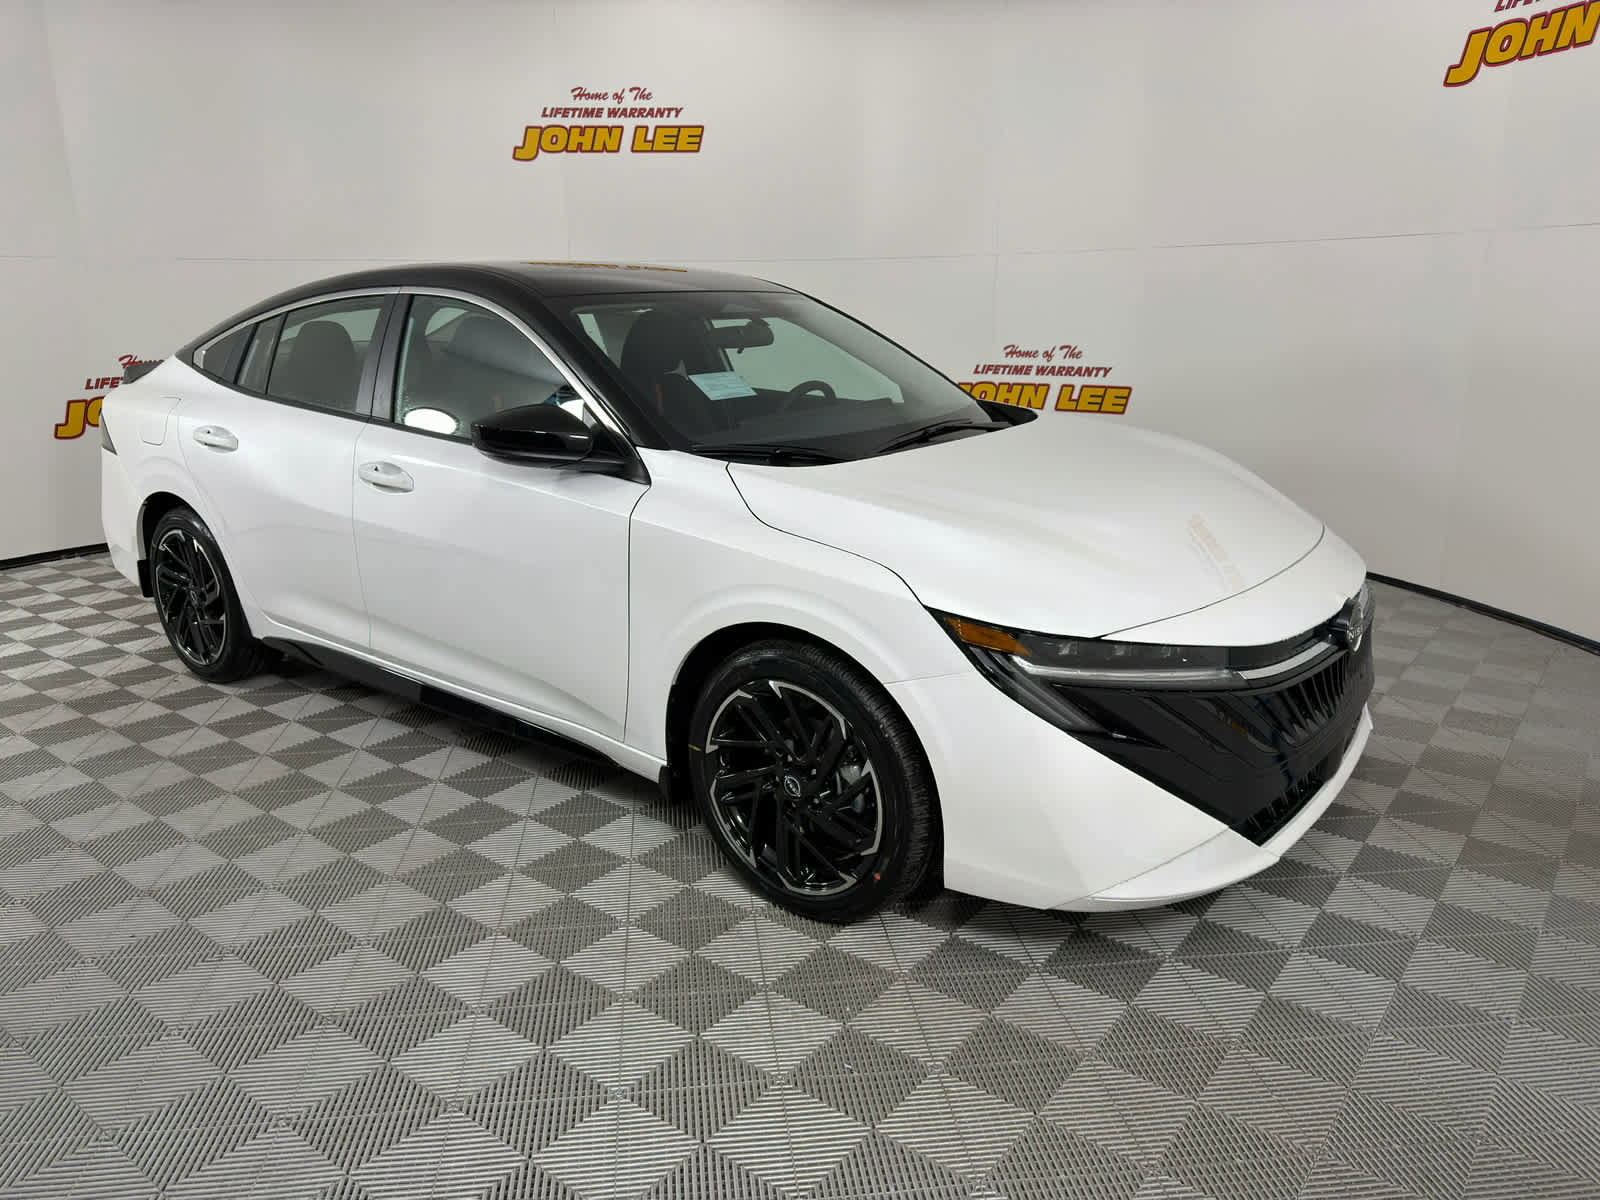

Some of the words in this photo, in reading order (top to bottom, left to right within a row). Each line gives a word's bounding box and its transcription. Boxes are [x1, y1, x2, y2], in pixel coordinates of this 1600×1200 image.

[1443, 0, 1600, 87] JOHN
[571, 86, 609, 101] Home
[612, 88, 625, 104] of
[629, 87, 652, 101] The
[541, 107, 604, 118] LIFETIME
[607, 107, 683, 118] WARRANTY
[512, 125, 624, 161] JOHN
[631, 125, 704, 152] LEE
[1003, 344, 1039, 359] Home
[1042, 346, 1056, 362] of
[1059, 345, 1082, 360] The
[973, 364, 1033, 376] LIFETIME
[1035, 365, 1112, 378] WARRANTY
[1054, 384, 1132, 415] LEE
